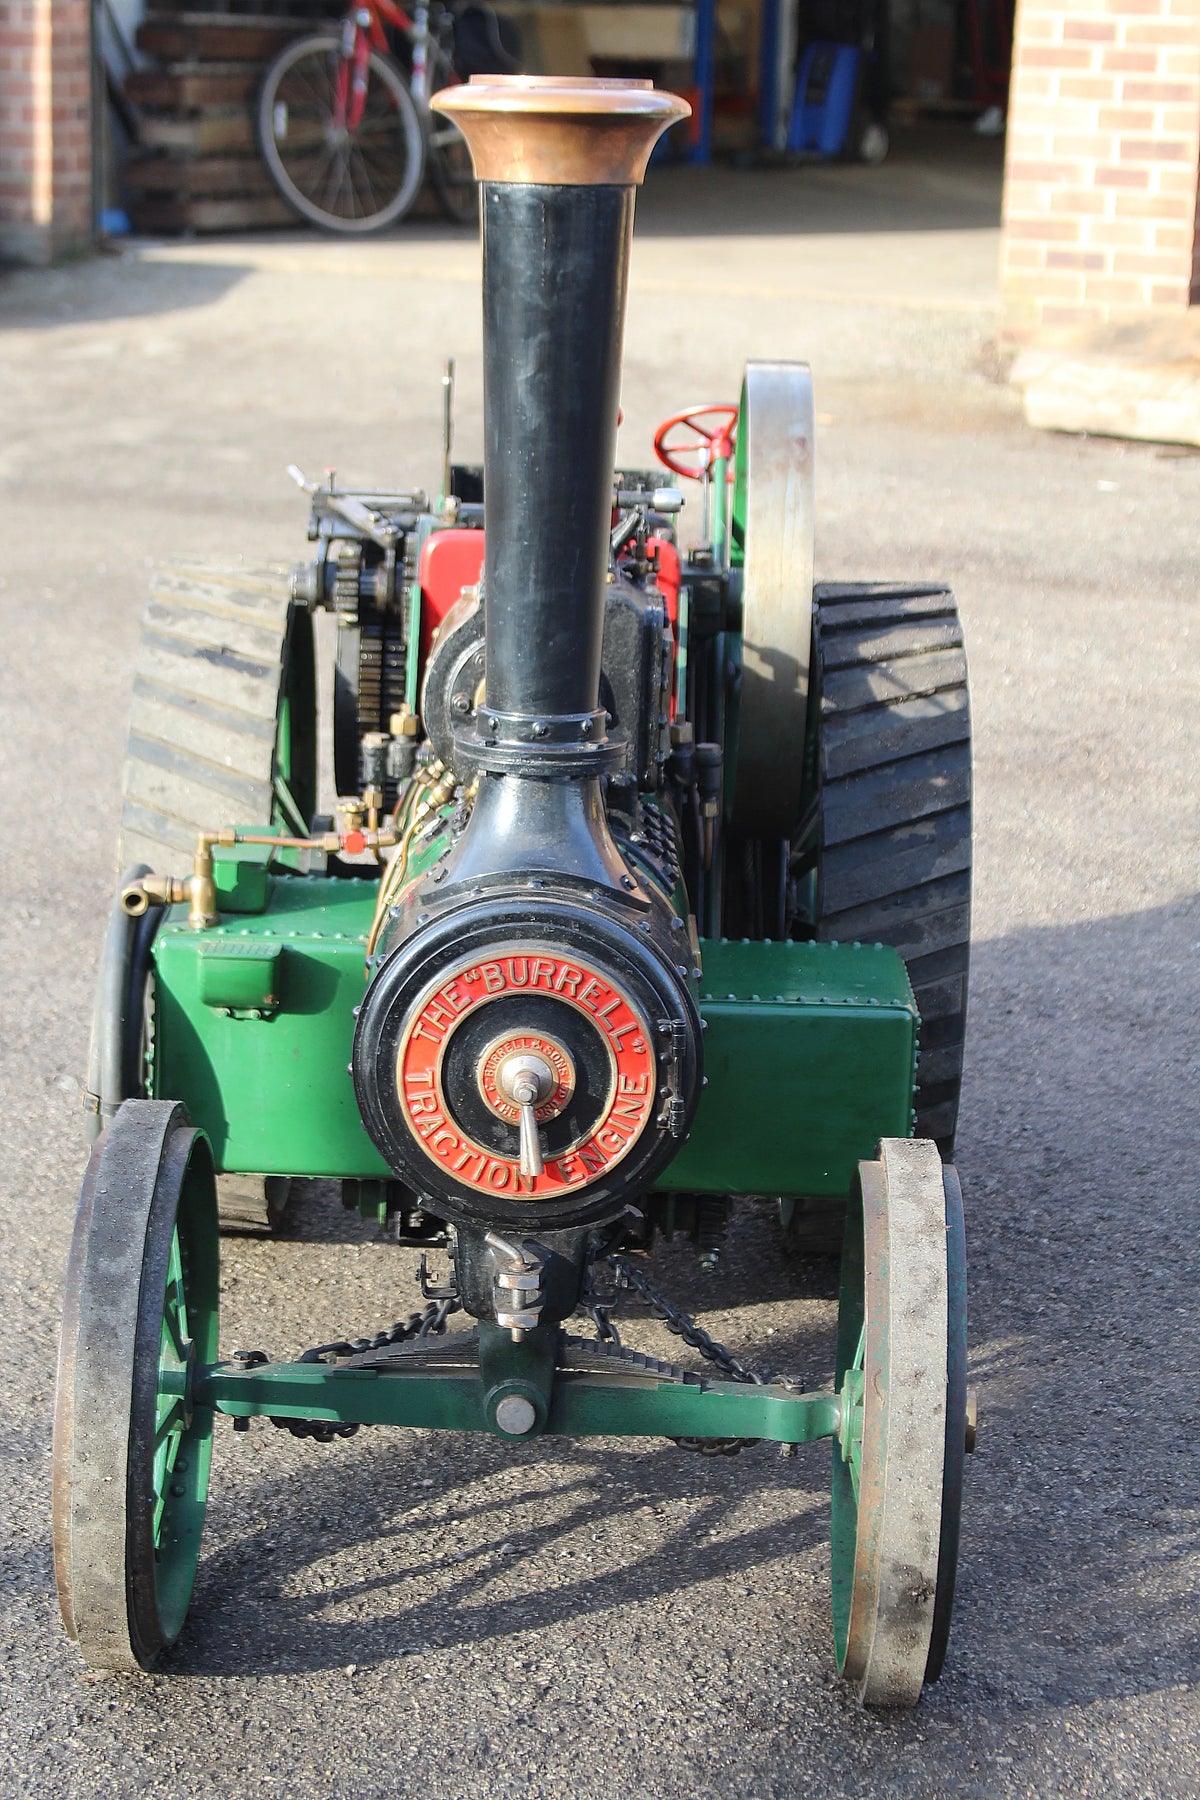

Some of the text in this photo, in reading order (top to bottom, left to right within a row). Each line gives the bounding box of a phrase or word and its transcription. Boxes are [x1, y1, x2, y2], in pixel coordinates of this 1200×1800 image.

[414, 981, 474, 1044] THE
[485, 1038, 529, 1076] BURRELL
[531, 1040, 543, 1051] &
[544, 1045, 569, 1077] SONS
[407, 1068, 649, 1191] TRACTION ENGINE
